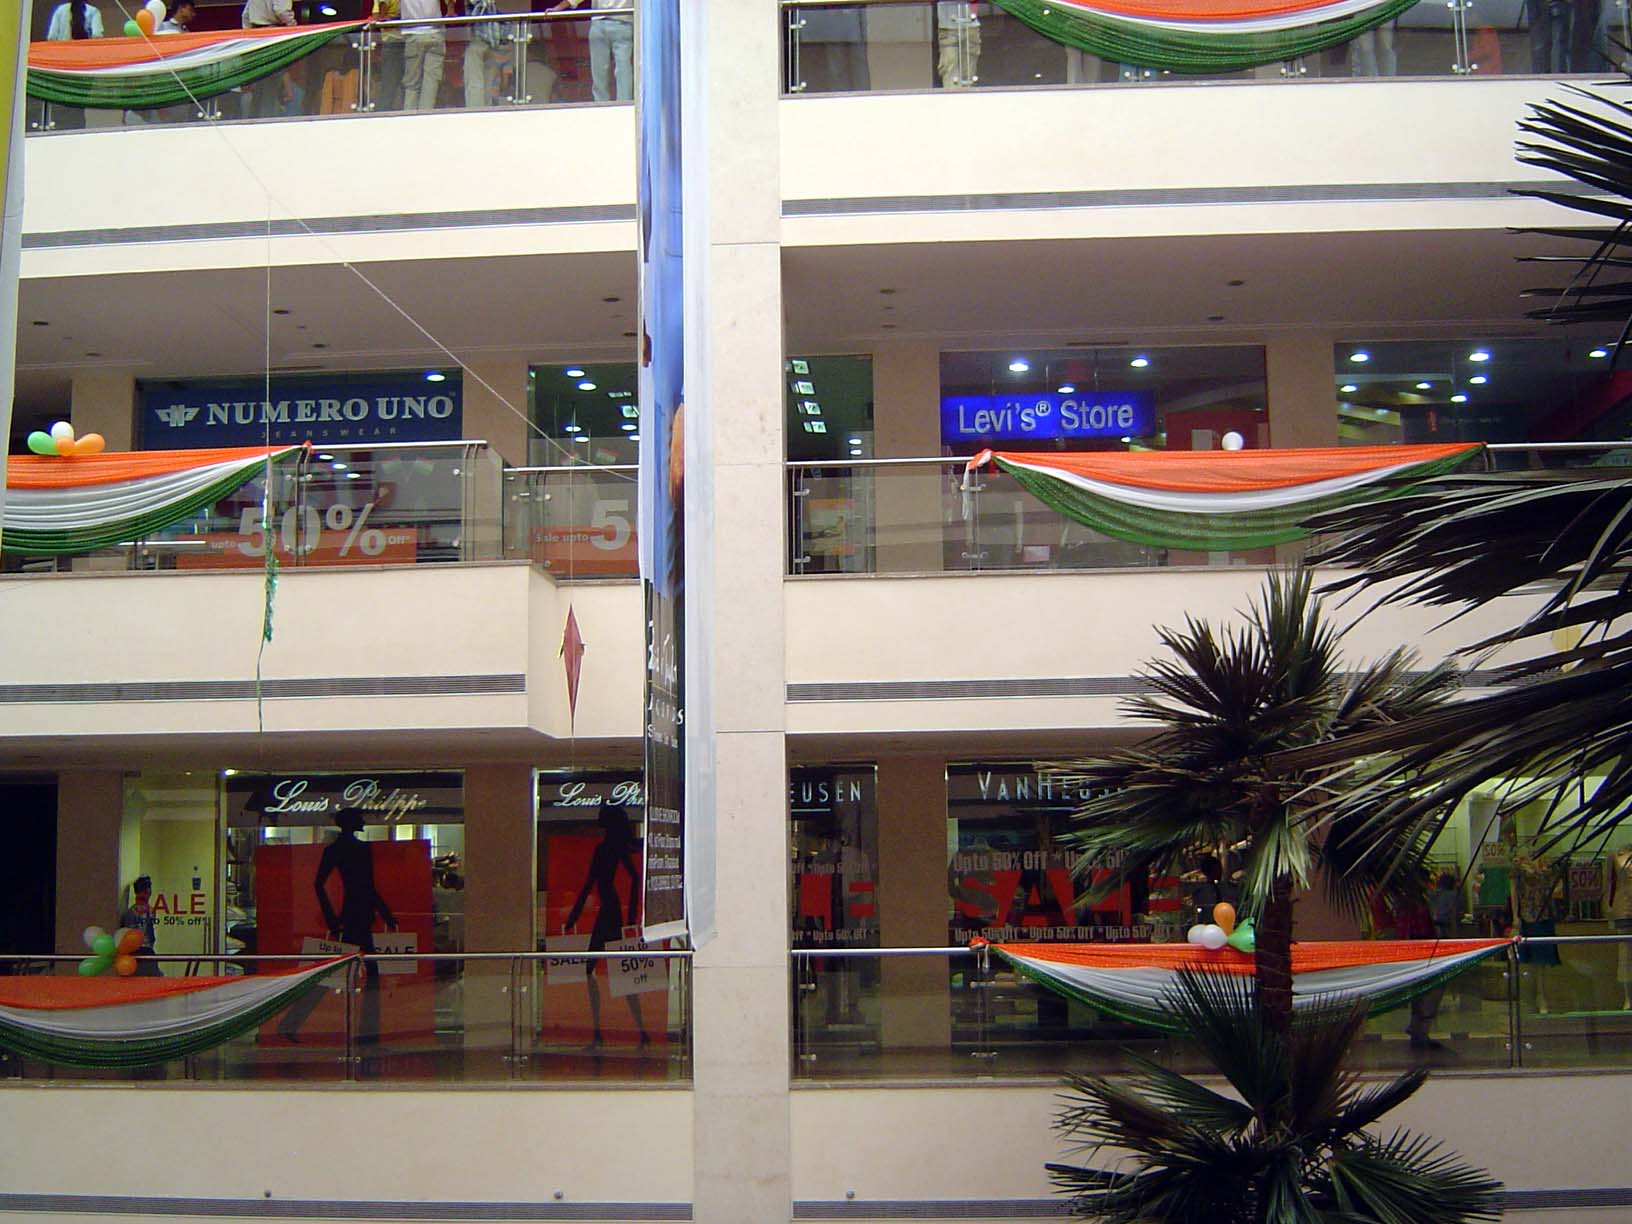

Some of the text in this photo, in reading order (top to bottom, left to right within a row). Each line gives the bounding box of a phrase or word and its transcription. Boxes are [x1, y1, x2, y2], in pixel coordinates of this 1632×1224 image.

[206, 396, 453, 425] NUMERO UNO
[1060, 400, 1133, 430] Store
[238, 502, 386, 557] 50%
[265, 778, 428, 821] Louis Philippe
[553, 782, 602, 807] Louis
[164, 917, 185, 926] 50%
[621, 956, 655, 973] 50%
